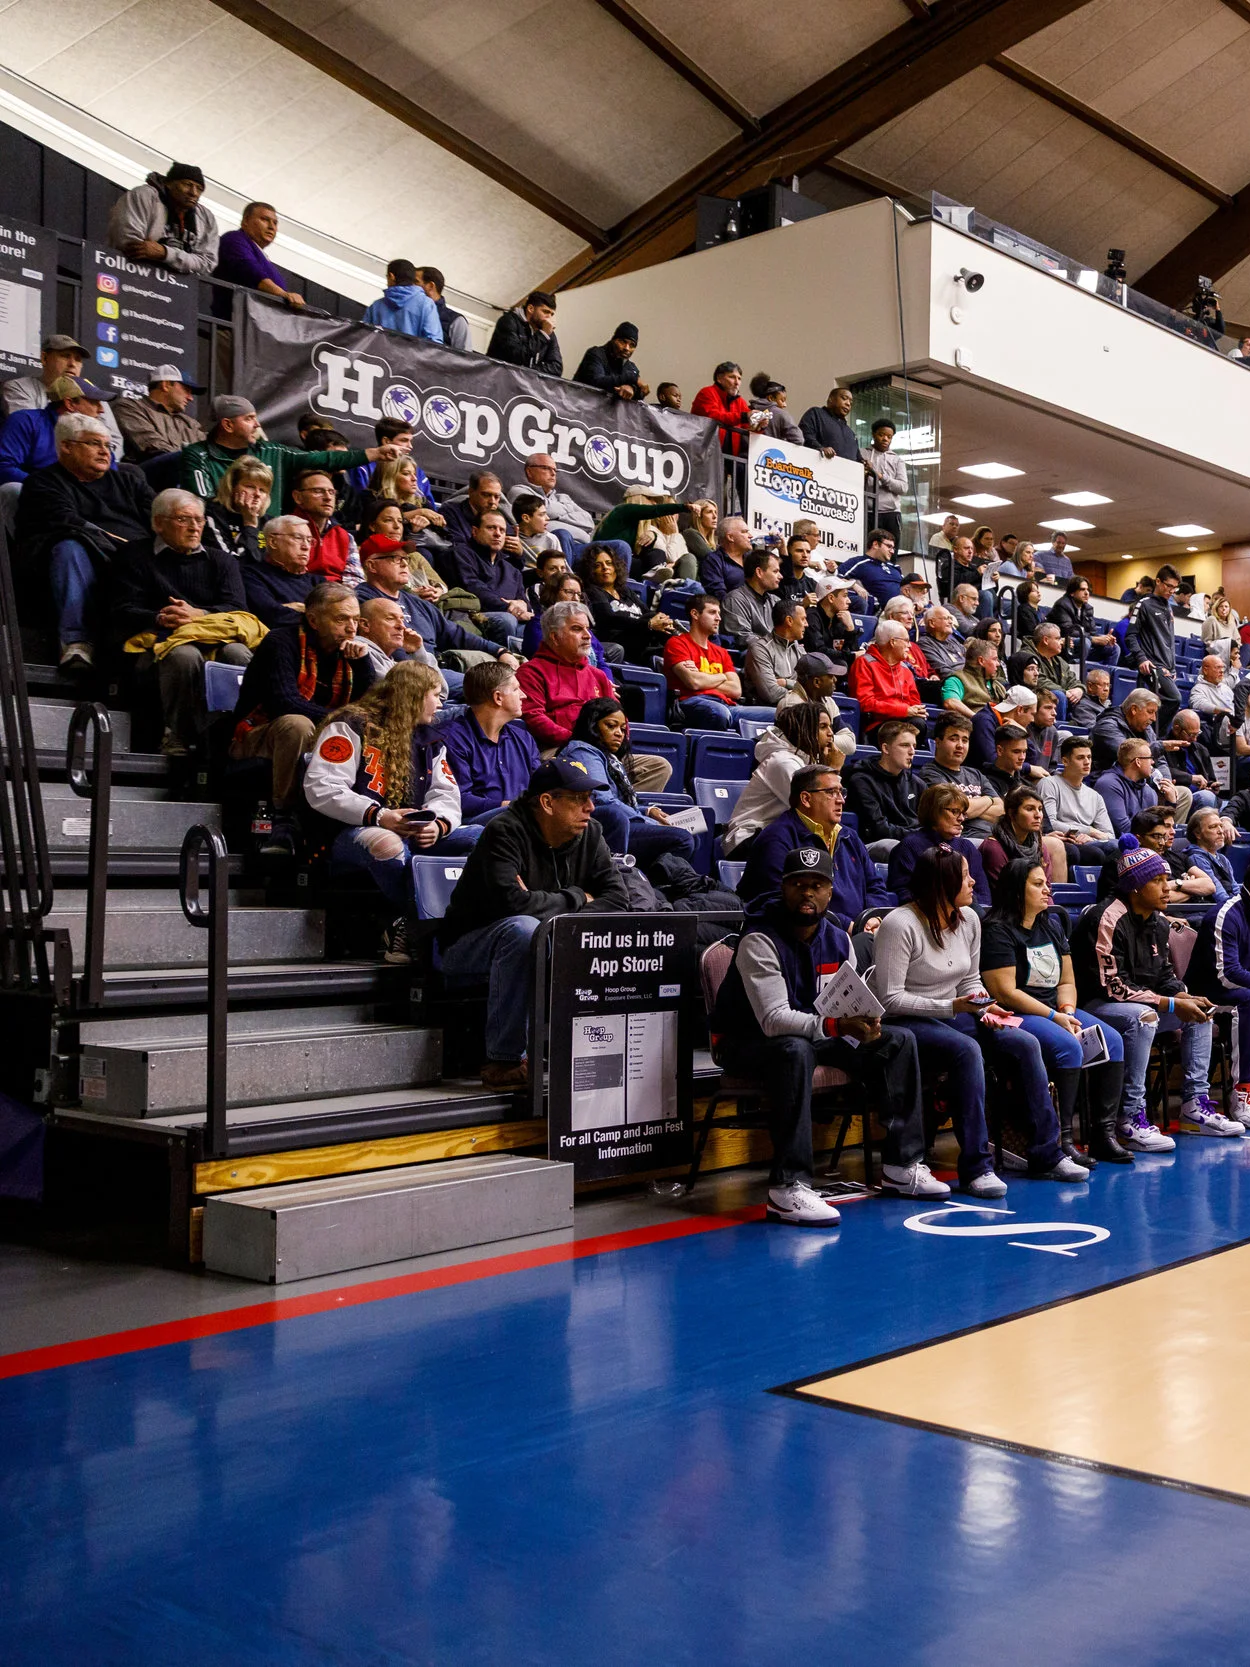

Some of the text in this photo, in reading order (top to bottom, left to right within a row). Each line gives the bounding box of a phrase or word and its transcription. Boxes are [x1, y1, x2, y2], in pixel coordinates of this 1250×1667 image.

[15, 230, 37, 246] the
[95, 250, 151, 278] Follow
[121, 308, 184, 330] @TheHoopGroup
[121, 333, 184, 354] @TheHoopGroup
[8, 354, 27, 365] Jam
[28, 359, 43, 369] Fes
[765, 457, 813, 479] Boardwalk
[755, 464, 858, 513] Hoop Group
[800, 498, 855, 523] Showcase
[719, 789, 724, 797] 5
[1128, 852, 1150, 867] NEW
[581, 931, 675, 949] Find us in the
[590, 955, 664, 977] App Store!
[583, 1026, 606, 1035] Hoop
[589, 1033, 613, 1042] Group
[560, 1121, 684, 1148] For all Camp and Jam Fest
[598, 1143, 653, 1160] Information
